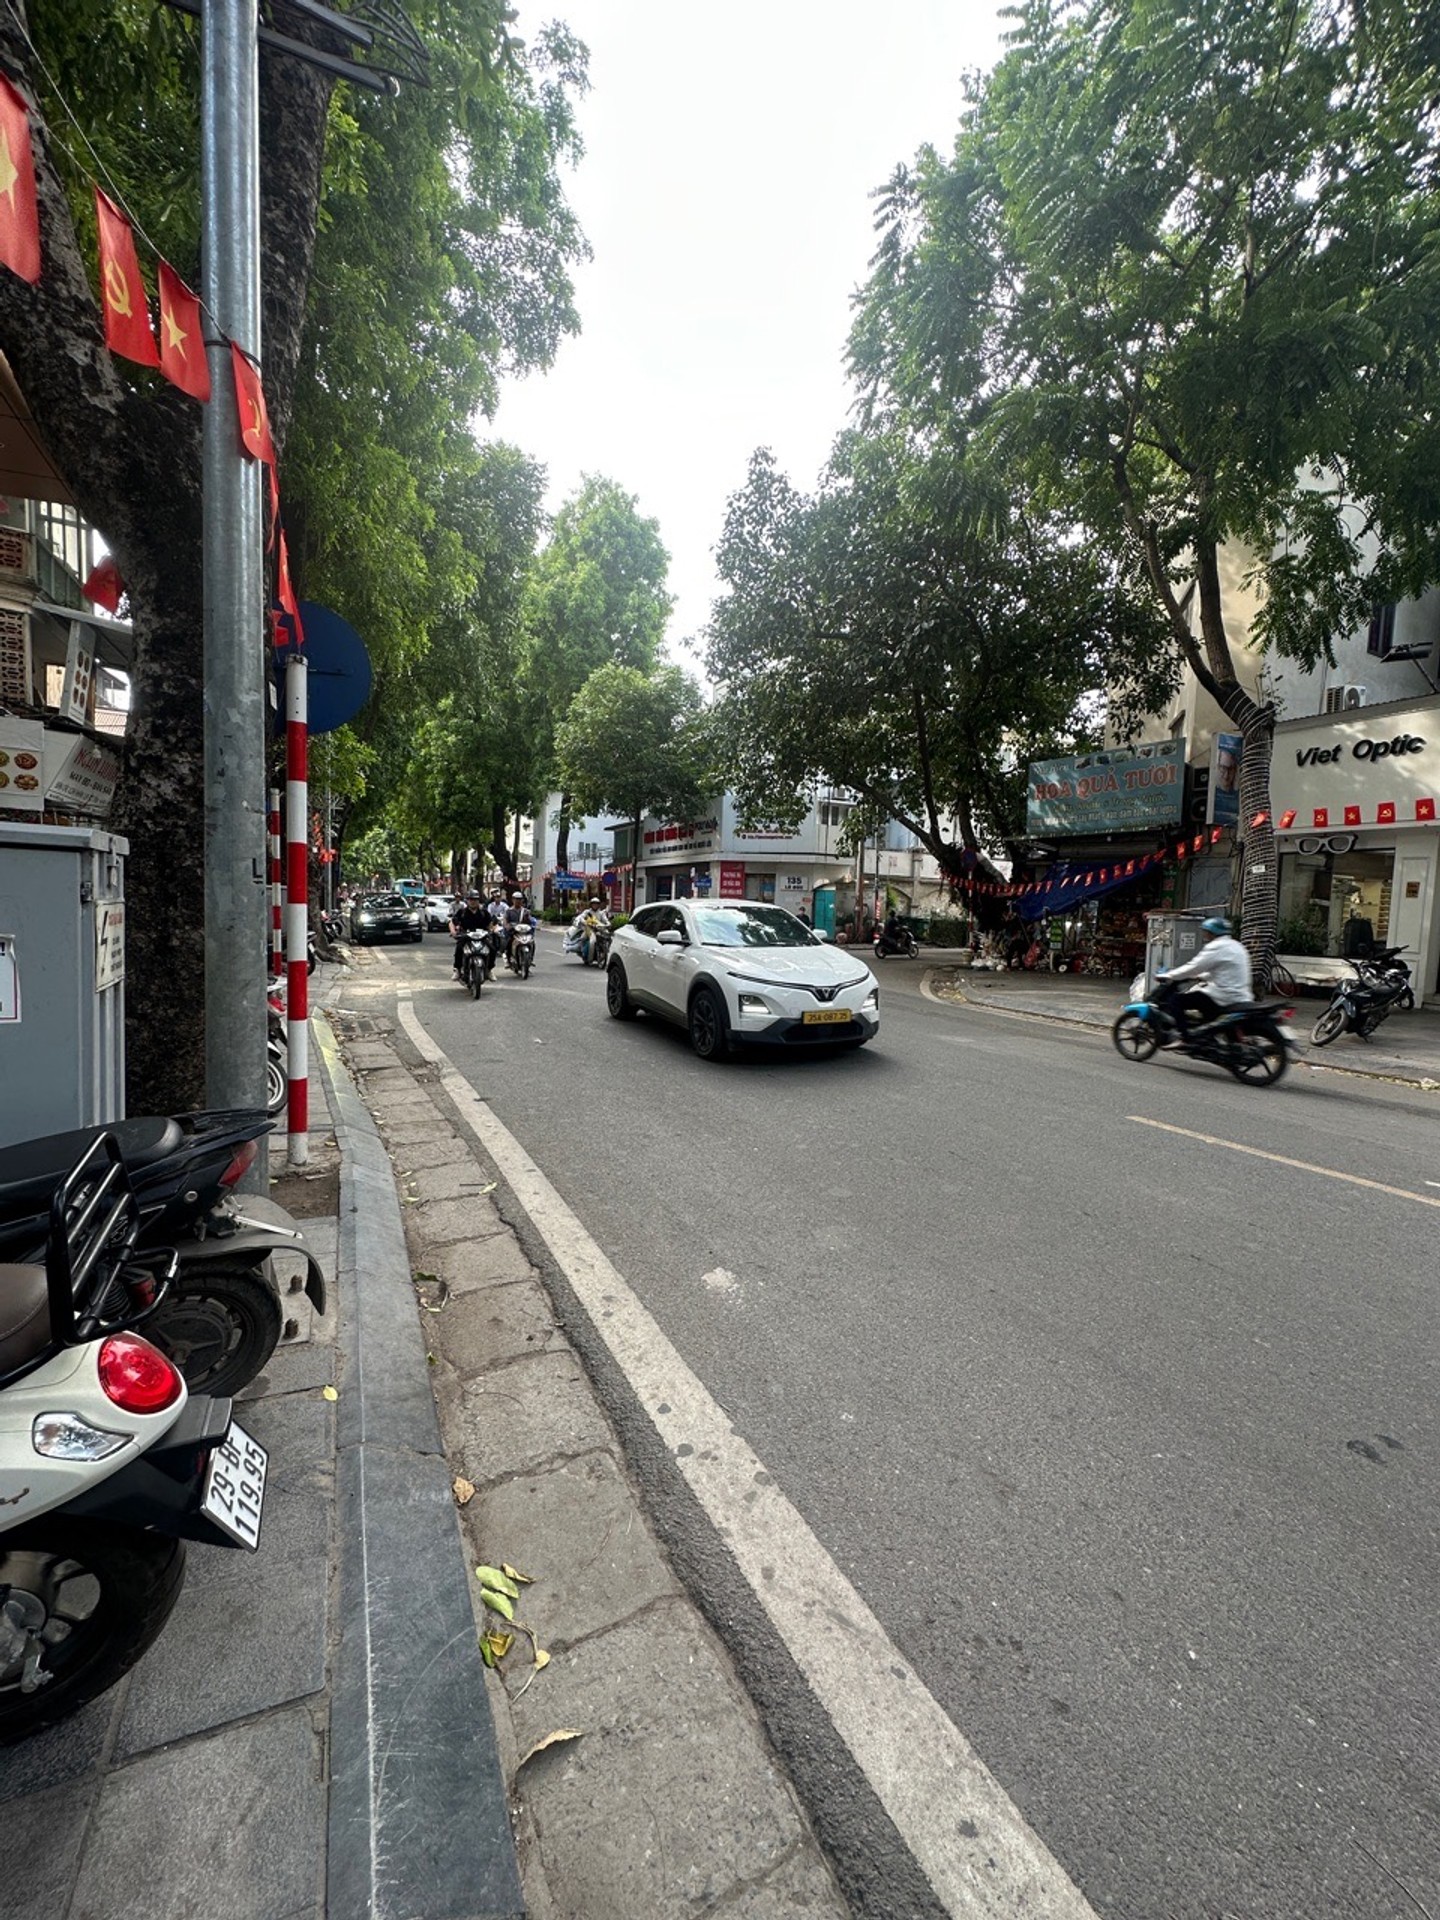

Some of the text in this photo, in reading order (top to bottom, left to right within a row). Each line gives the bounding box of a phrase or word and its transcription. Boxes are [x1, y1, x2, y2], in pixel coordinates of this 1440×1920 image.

[1296, 734, 1426, 767] Viet Optic
[1035, 781, 1072, 800] HOA
[1076, 767, 1119, 799] QUẢ
[1124, 763, 1178, 790] TƯƠI
[787, 876, 802, 885] 135
[210, 1436, 242, 1513] 29-BF
[234, 1441, 265, 1537] 119.95
